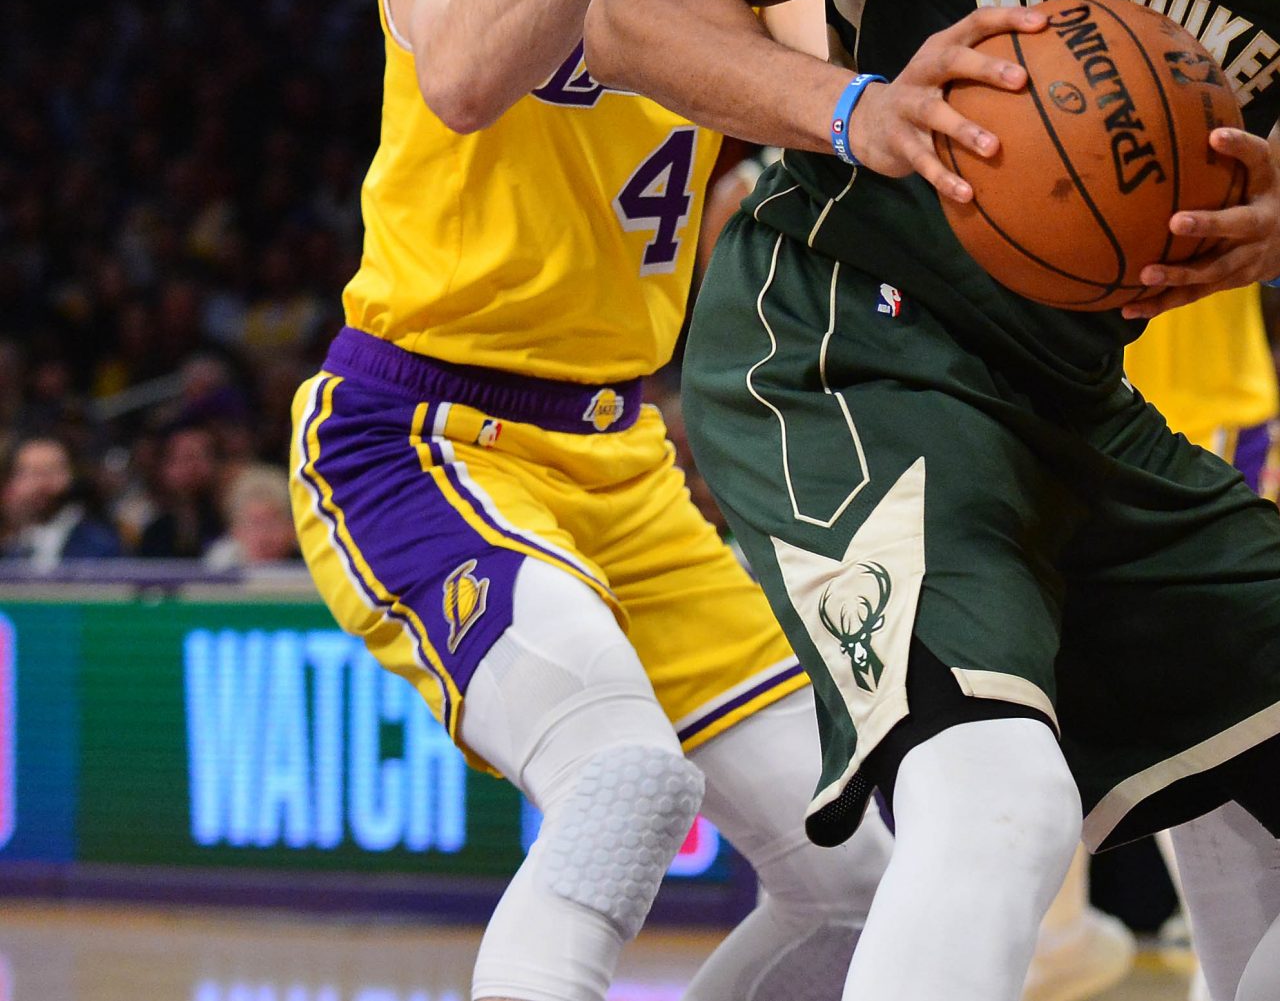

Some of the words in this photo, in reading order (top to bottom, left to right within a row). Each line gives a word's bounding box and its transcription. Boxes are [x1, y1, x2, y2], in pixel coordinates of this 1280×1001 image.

[1046, 4, 1167, 196] SPALDING
[612, 126, 699, 277] 4
[184, 629, 466, 852] WATCH
